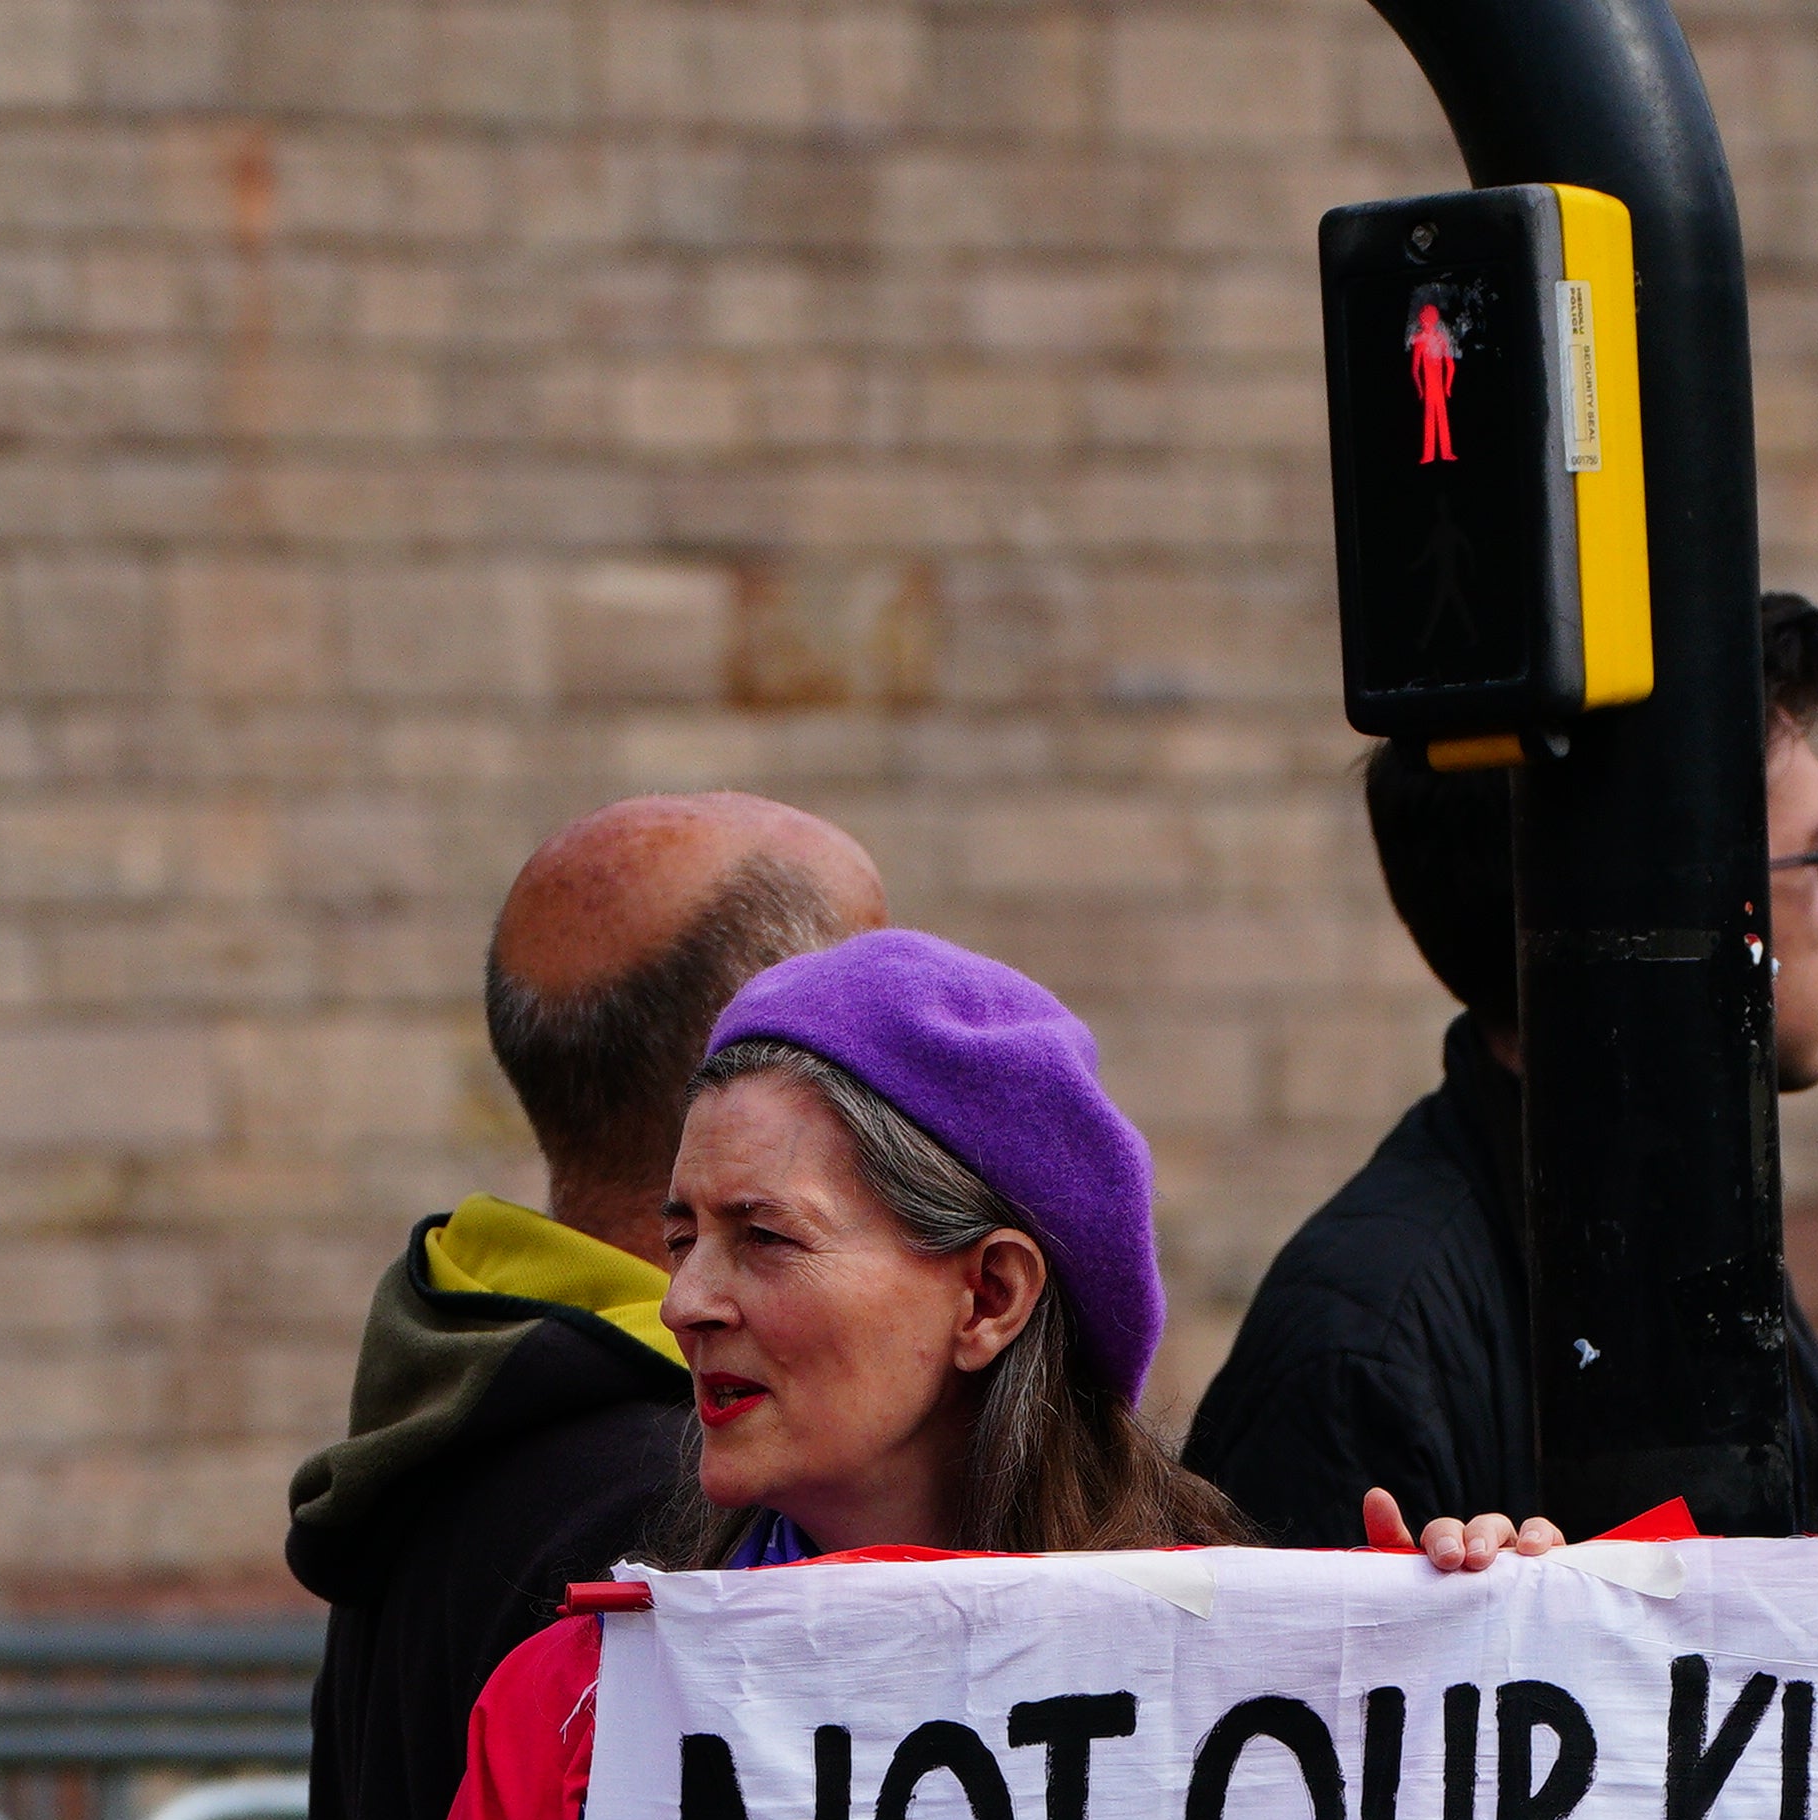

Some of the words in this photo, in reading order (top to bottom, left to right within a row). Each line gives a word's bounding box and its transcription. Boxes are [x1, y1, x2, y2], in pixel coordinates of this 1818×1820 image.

[1569, 287, 1579, 335] POLICE
[1583, 344, 1594, 408] SECURITY
[1587, 411, 1596, 442] SEAL
